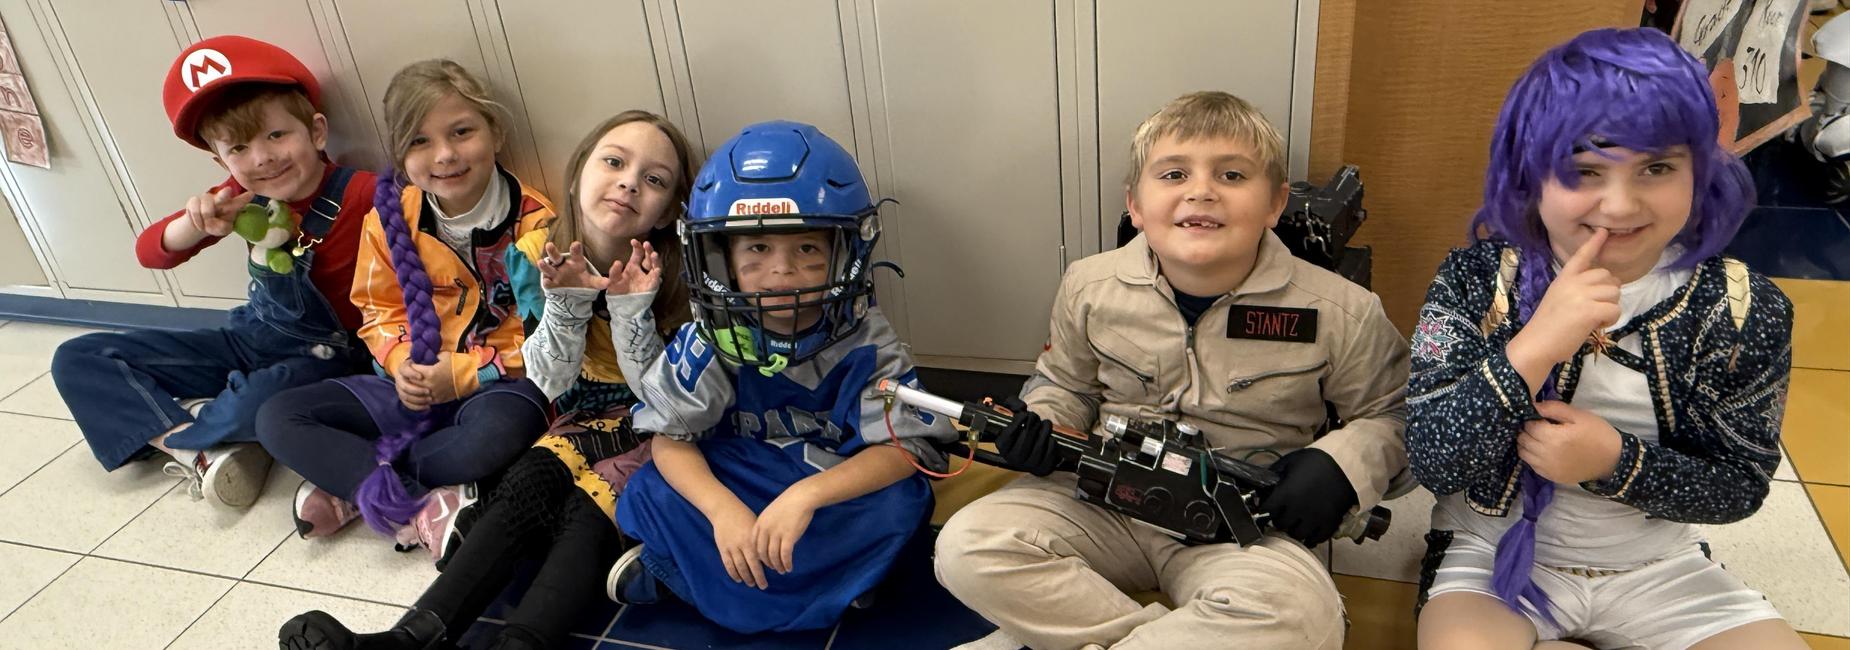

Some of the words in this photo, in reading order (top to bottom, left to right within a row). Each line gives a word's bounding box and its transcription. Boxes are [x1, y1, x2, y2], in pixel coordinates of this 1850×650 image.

[190, 54, 227, 88] M
[1738, 46, 1767, 95] 310
[736, 201, 791, 216] Riddell
[1245, 310, 1300, 337] STANTZ
[770, 339, 798, 350] Riddel
